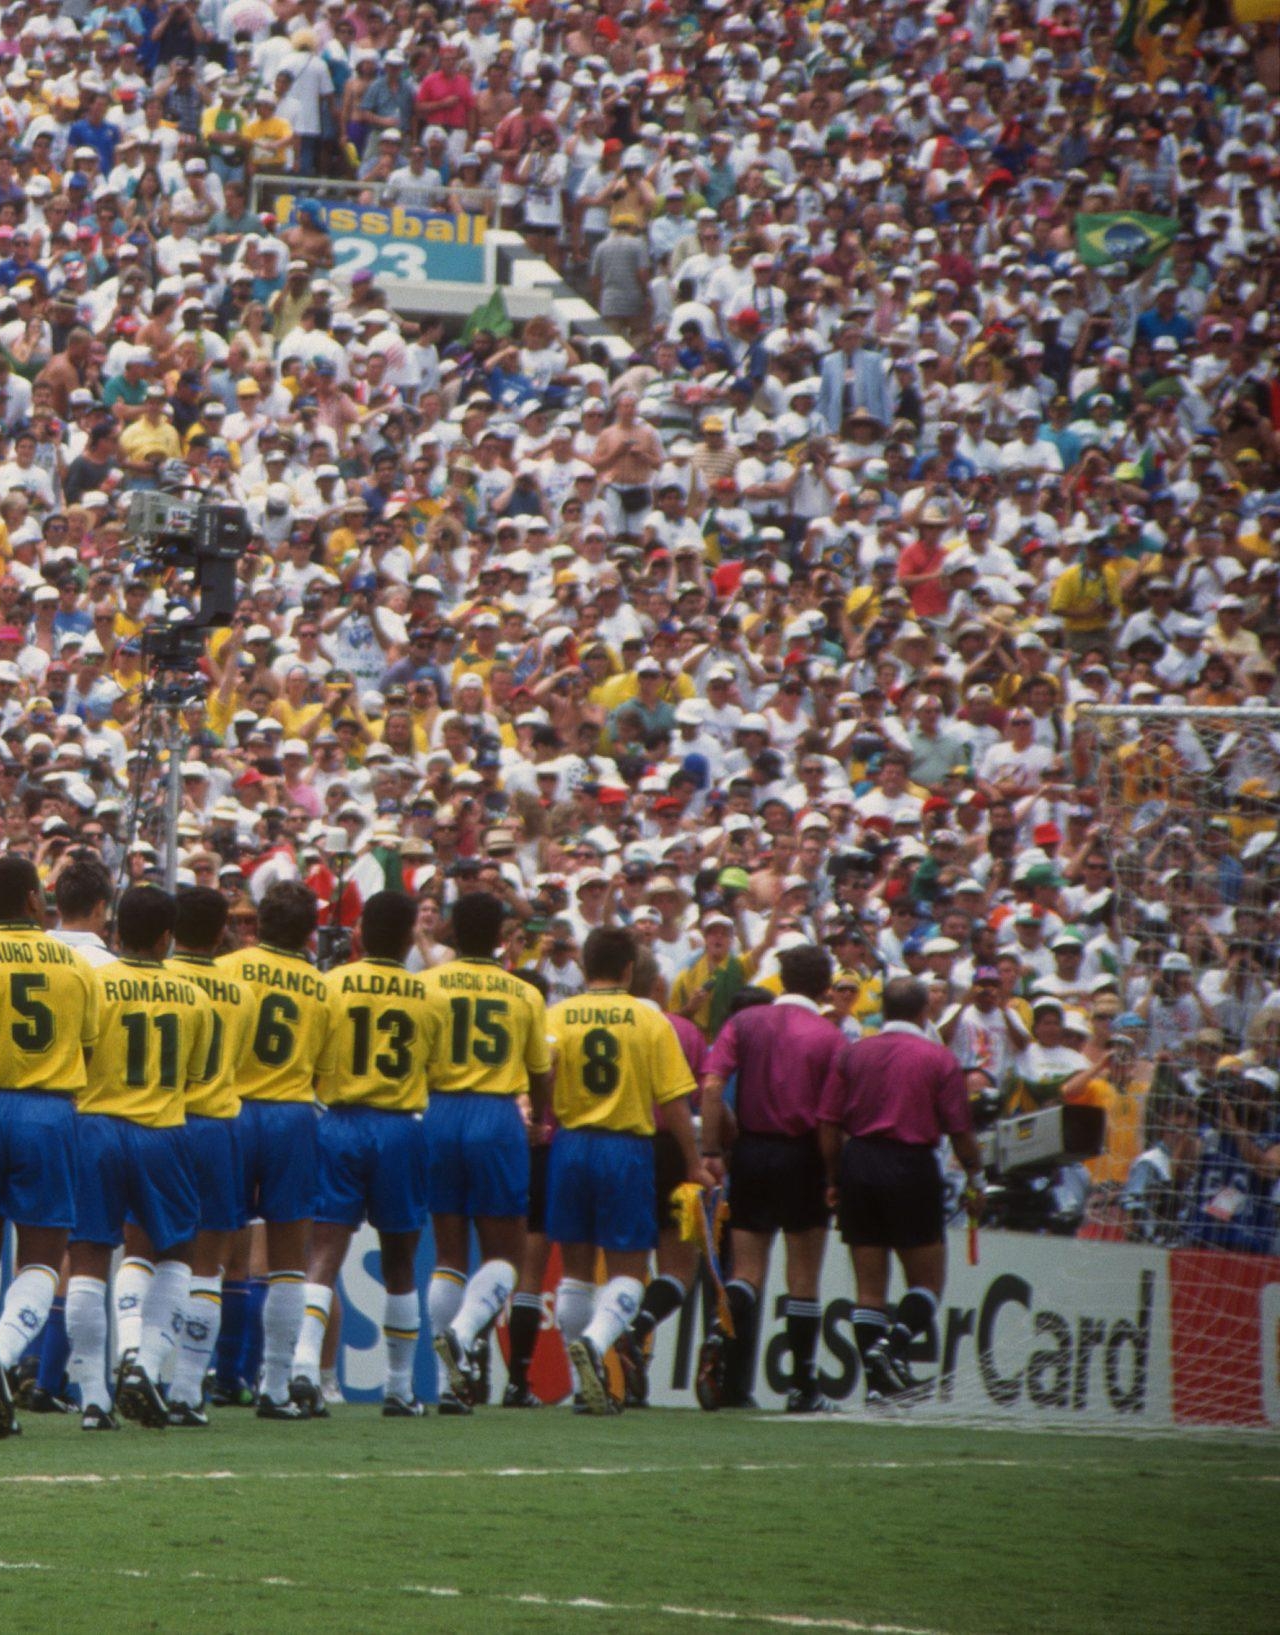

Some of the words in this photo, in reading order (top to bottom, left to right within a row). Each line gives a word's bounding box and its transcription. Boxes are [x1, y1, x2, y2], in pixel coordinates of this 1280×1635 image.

[275, 194, 488, 245] fssball
[329, 237, 427, 283] 23
[105, 975, 196, 1006] ROMÁRIO
[242, 964, 328, 1001] BRANCO
[342, 975, 426, 1000] ALDAIR
[10, 972, 56, 1053] 5
[253, 992, 300, 1067] 6
[450, 997, 510, 1066] 15
[565, 1008, 637, 1027] DUNGA
[121, 1012, 181, 1090] 11
[348, 1006, 416, 1081] 13
[583, 1028, 619, 1096] 8
